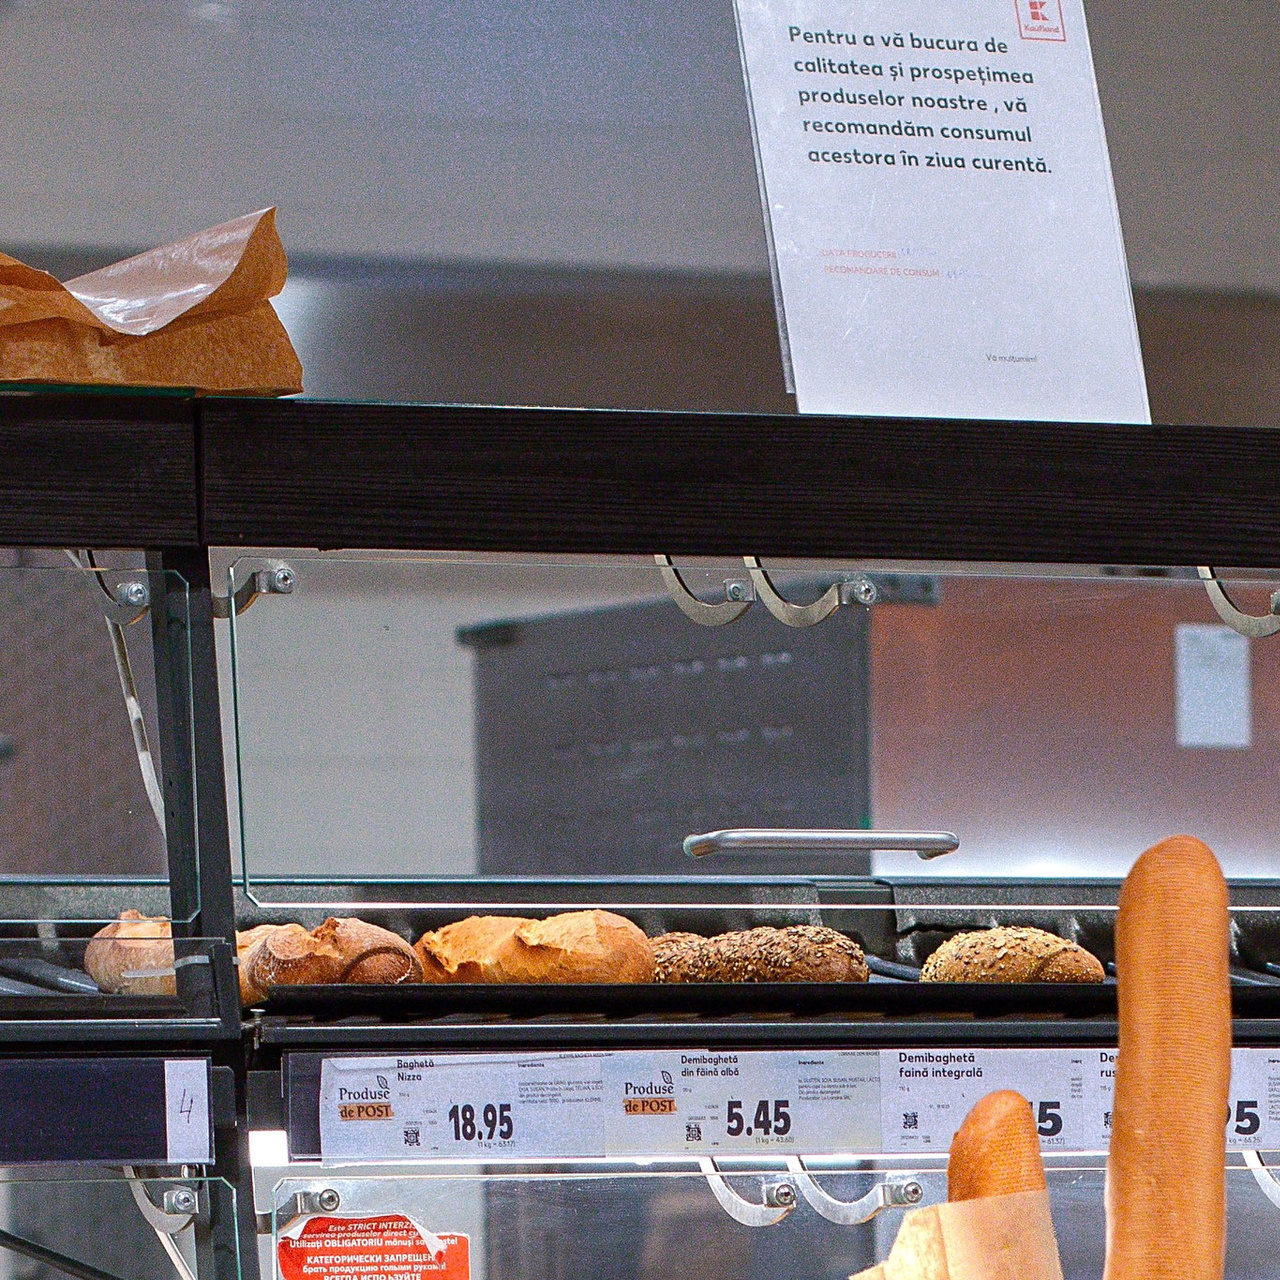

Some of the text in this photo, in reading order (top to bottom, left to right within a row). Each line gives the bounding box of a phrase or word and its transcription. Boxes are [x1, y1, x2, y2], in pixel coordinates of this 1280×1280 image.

[789, 26, 1008, 53] Pentru a vă bucura de
[794, 58, 1034, 85] calitatea și prospețimea
[799, 88, 904, 106] produselor
[912, 94, 988, 110] noastre
[1004, 98, 1028, 112] vă
[803, 119, 1031, 142] recomandăm consumul
[808, 149, 1052, 173] acestora în ziua curentă.
[397, 1059, 434, 1069] Baghetă
[681, 1055, 738, 1066] Demibaghetă
[899, 1052, 975, 1065] Demibaghetă
[398, 1072, 422, 1081] Nizza
[682, 1068, 739, 1077] din făină albă
[932, 1067, 983, 1079] integrală
[340, 1088, 390, 1100] Produse
[625, 1082, 674, 1095] Produse
[180, 1088, 193, 1124] 4
[340, 1105, 392, 1118] de POST
[625, 1101, 674, 1112] de POST
[449, 1103, 513, 1141] 18.95
[727, 1100, 791, 1136] 5.45
